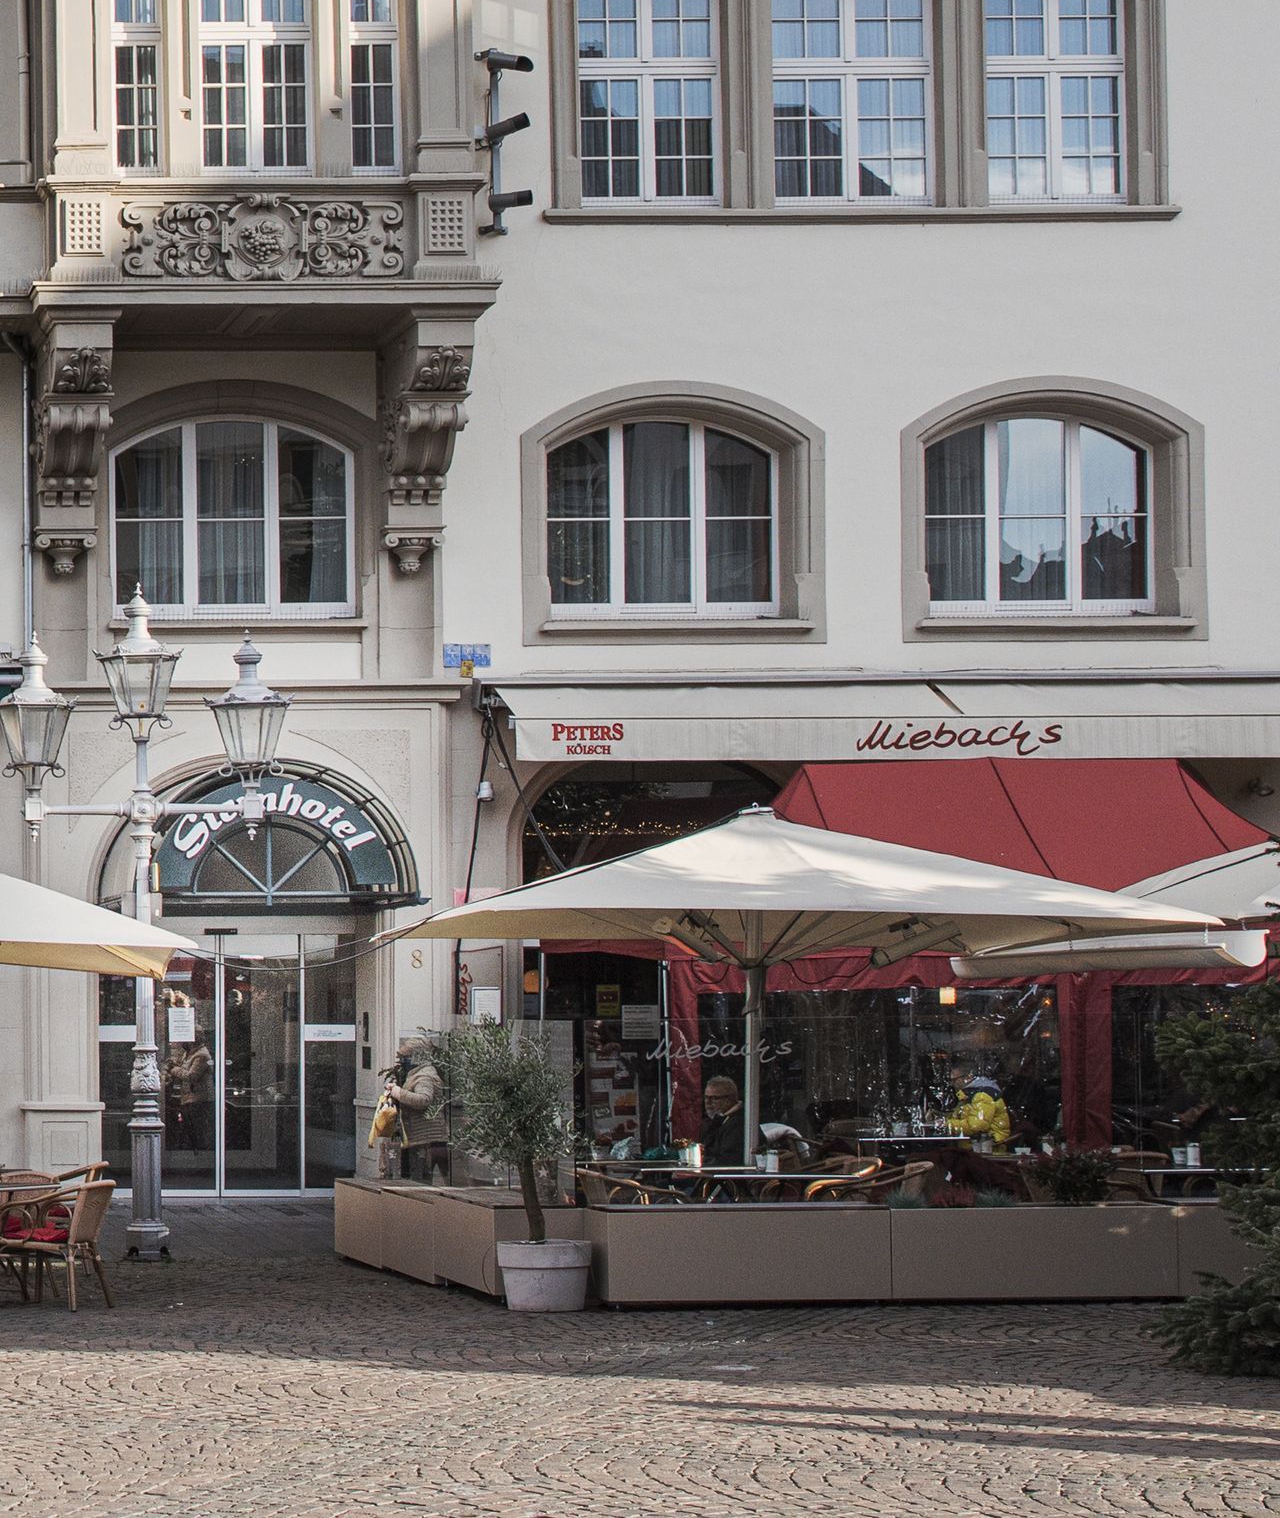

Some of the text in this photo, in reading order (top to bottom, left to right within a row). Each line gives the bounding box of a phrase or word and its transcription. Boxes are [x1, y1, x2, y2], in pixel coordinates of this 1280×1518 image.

[551, 722, 624, 741] PETERS
[856, 719, 1063, 756] Miebachs
[566, 743, 611, 755] KÖLSCH
[411, 949, 423, 969] 8
